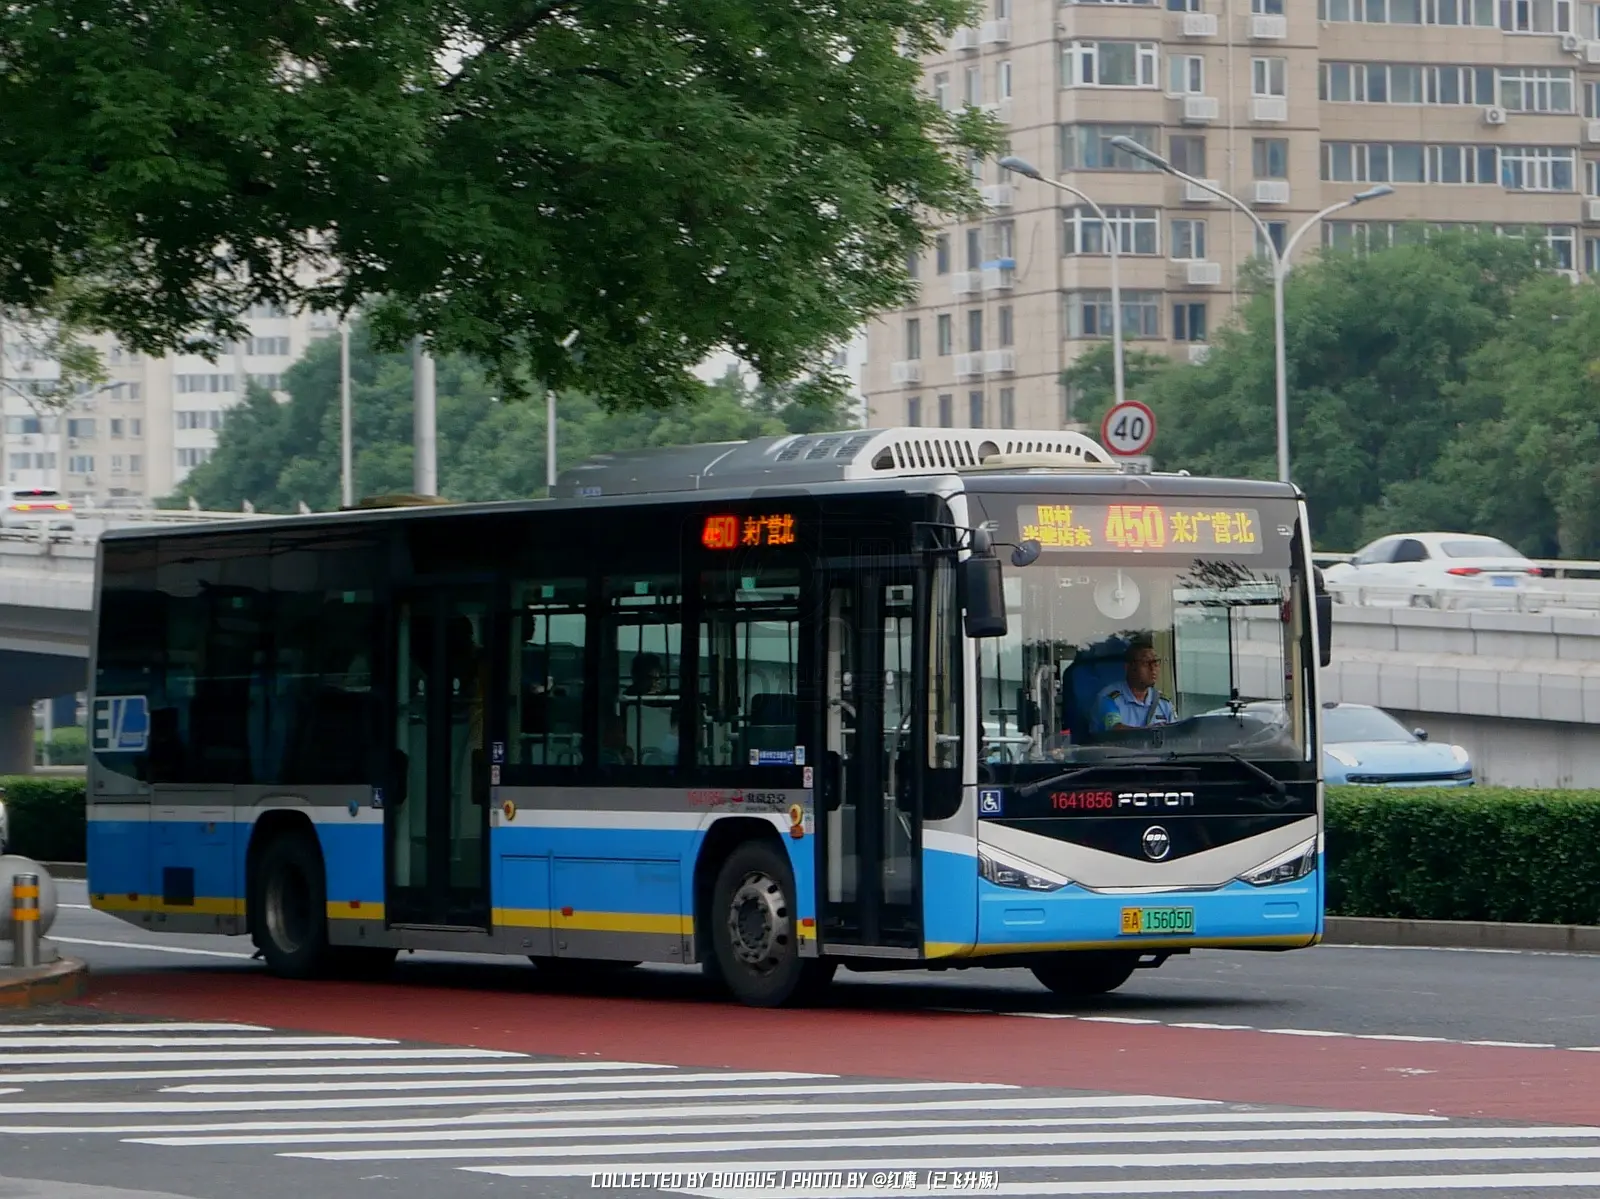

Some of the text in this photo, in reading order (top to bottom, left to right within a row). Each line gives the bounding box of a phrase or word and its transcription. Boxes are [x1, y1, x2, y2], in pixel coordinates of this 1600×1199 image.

[1114, 415, 1144, 441] 40
[702, 514, 794, 548] 450 来广营北
[1105, 505, 1254, 547] 450 来广营北
[1051, 792, 1194, 809] 1641856 FOTON
[1146, 911, 1193, 929] 15605D
